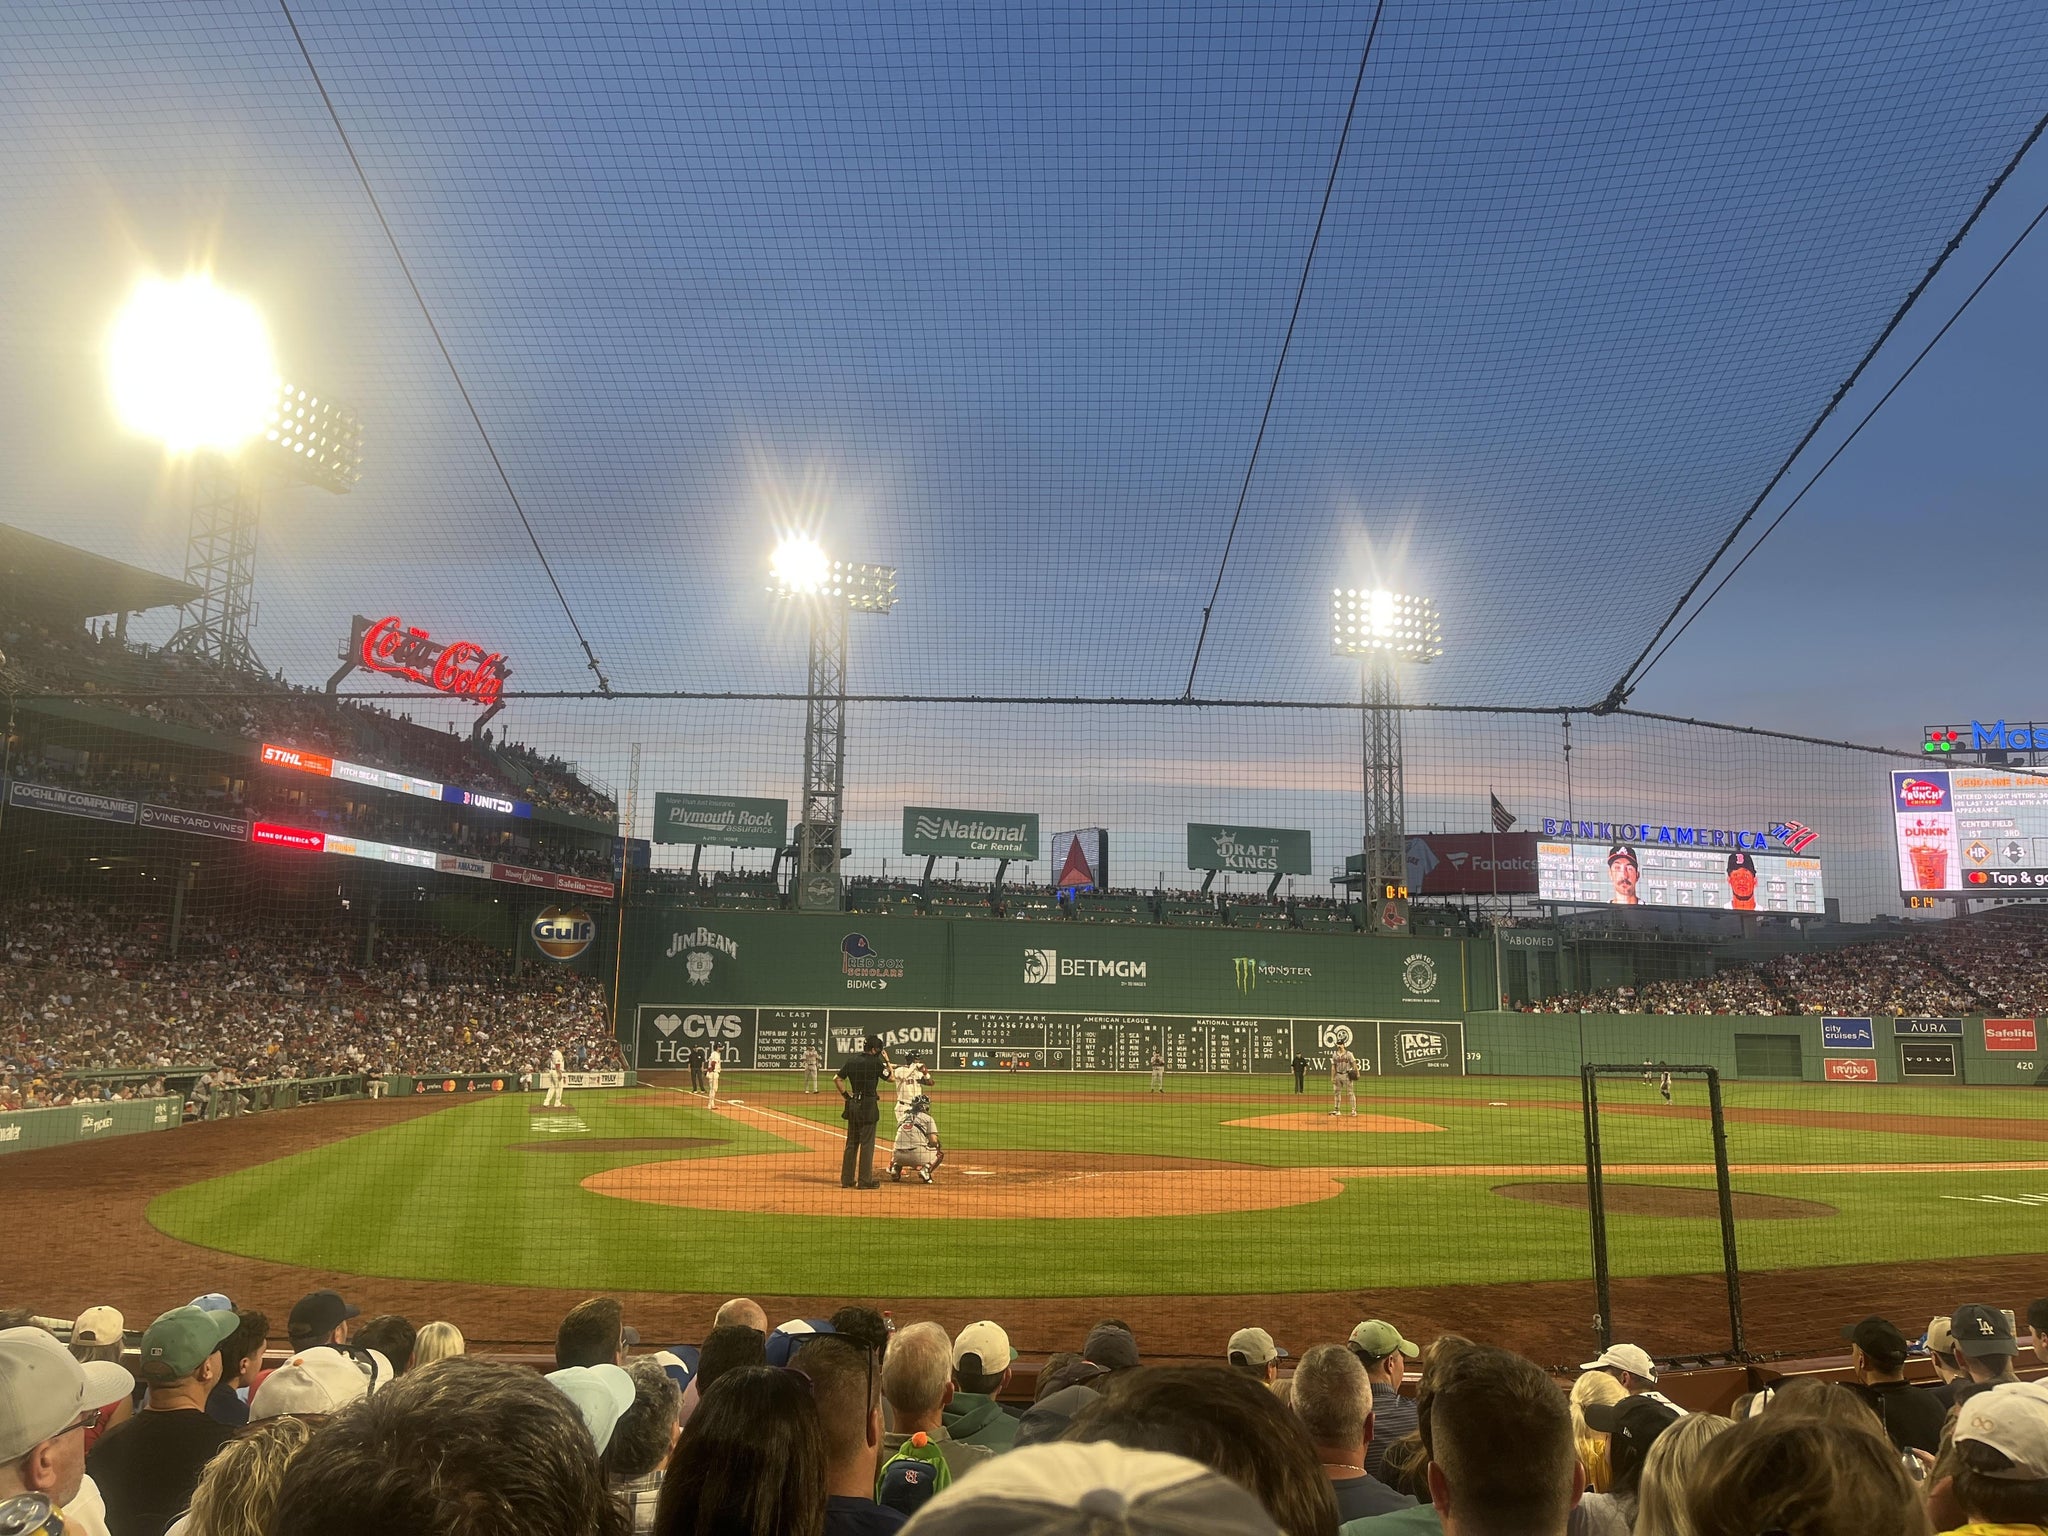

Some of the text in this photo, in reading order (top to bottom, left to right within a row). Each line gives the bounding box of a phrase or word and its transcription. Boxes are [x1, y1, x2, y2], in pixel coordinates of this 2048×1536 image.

[432, 640, 502, 704] Cola
[264, 748, 302, 766] STIHL
[13, 785, 66, 804] COGHLIN
[67, 794, 135, 814] COMPANIES
[666, 796, 682, 805] More
[1900, 788, 1946, 800] KRUNCHY
[2011, 792, 2036, 800] HITTING
[474, 794, 514, 814] UNITED
[152, 810, 246, 834] VINEYARD VINES
[668, 806, 774, 826] Plymouth Rock
[940, 819, 1026, 842] National
[1543, 818, 1768, 849] BANK OF AMERICA
[1905, 827, 1950, 837] DUNKIN'
[1968, 830, 1982, 838] 1ST
[257, 830, 274, 840] BANK
[282, 834, 309, 845] AMERICA
[970, 842, 1022, 852] Car Rental
[1216, 842, 1280, 858] DRAFT
[1970, 848, 2025, 857] HR 4-3
[1656, 850, 1691, 859] CHALLENGES
[1692, 852, 1722, 860] REMAINING
[1736, 854, 1744, 864] B
[1225, 854, 1278, 870] KINGS
[1471, 856, 1538, 870] Fanatics
[1646, 858, 1658, 866] ATL
[531, 874, 544, 883] Nine
[1586, 872, 1595, 880] 65
[1989, 871, 2017, 886] Tap
[2020, 872, 2032, 883] &
[558, 878, 586, 891] Safelite
[1673, 881, 1697, 889] STRIKES
[1702, 882, 1719, 890] OUTS
[1386, 885, 1408, 899] 0:14
[1655, 891, 1715, 904] 2 2 2
[1910, 896, 1934, 909] 0:14
[534, 921, 591, 940] Gulf
[666, 926, 740, 960] JIM BEAM
[1509, 936, 1554, 946] ABIOMED
[848, 958, 904, 969] RED SOX
[1404, 954, 1435, 967] IBEW 103
[848, 968, 904, 977] SCHOLARS
[1061, 958, 1146, 978] BETMGM
[1258, 965, 1312, 976] MONSTER
[846, 980, 877, 989] BIDMC
[683, 1014, 742, 1038] CVS
[831, 1028, 864, 1036] WHO BUT
[1825, 1024, 1841, 1034] city
[1318, 1024, 1354, 1048] 160
[1825, 1032, 1857, 1040] cruises
[1985, 1028, 2034, 1038] Safelite
[1405, 1033, 1442, 1049] ACE
[654, 1040, 741, 1063] Healh
[1406, 1047, 1442, 1060] TICKET
[1466, 1052, 1481, 1060] 379
[960, 1057, 966, 1068] 3
[2016, 1062, 2034, 1070] 420
[1832, 1066, 1869, 1075] IRVING
[567, 1074, 584, 1083] TRULY
[601, 1074, 617, 1082] TRULY
[93, 1117, 113, 1134] TICKET
[1976, 1318, 1994, 1335] LA
